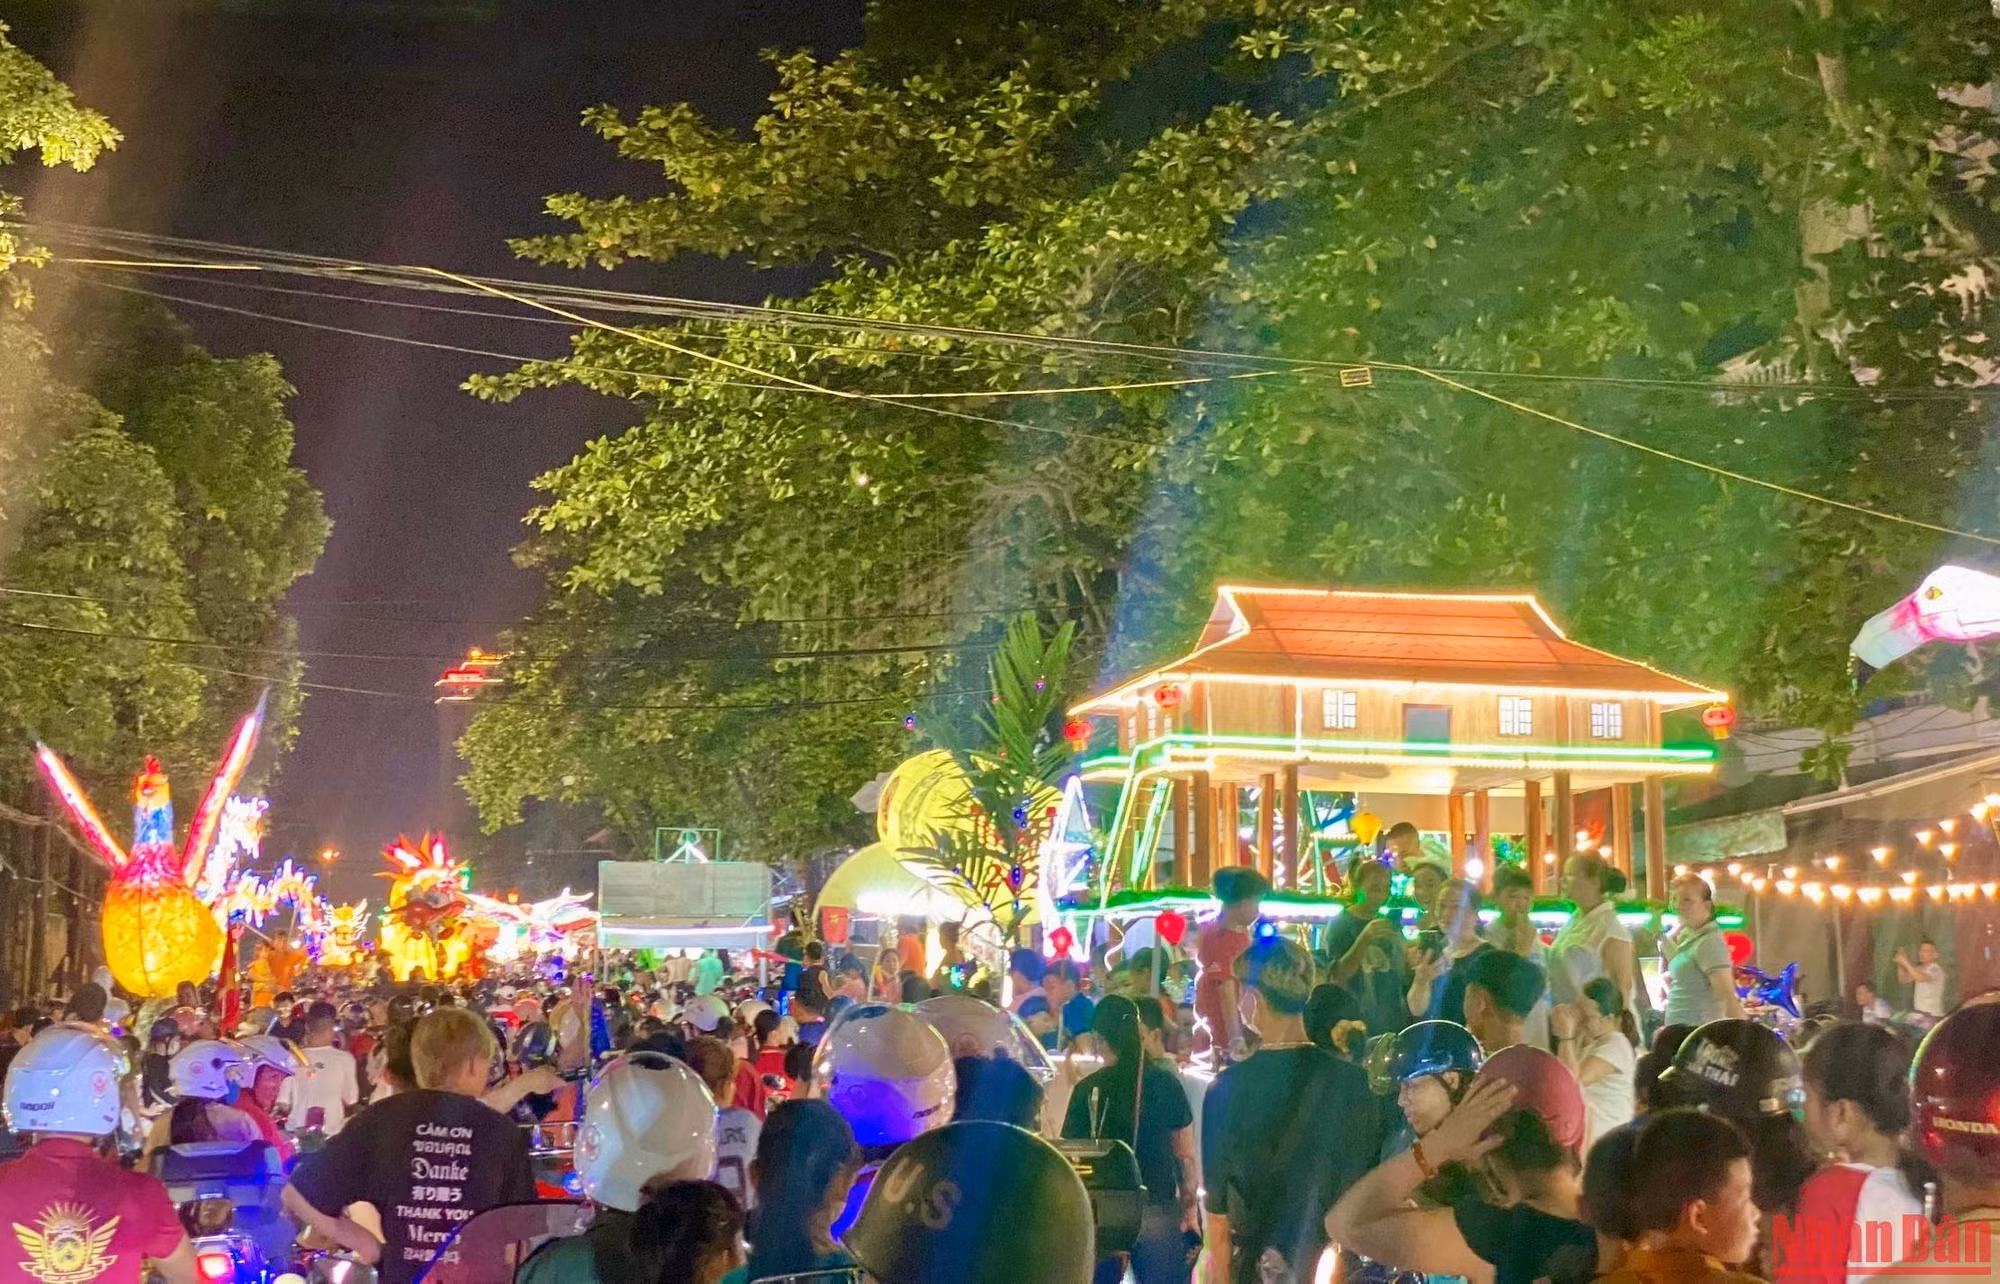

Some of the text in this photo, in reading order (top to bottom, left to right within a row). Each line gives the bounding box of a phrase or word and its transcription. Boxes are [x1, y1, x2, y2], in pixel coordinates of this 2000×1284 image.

[1932, 1115, 1999, 1134] HONDA
[411, 1156, 469, 1181] Danke
[396, 1204, 442, 1220] THANK
